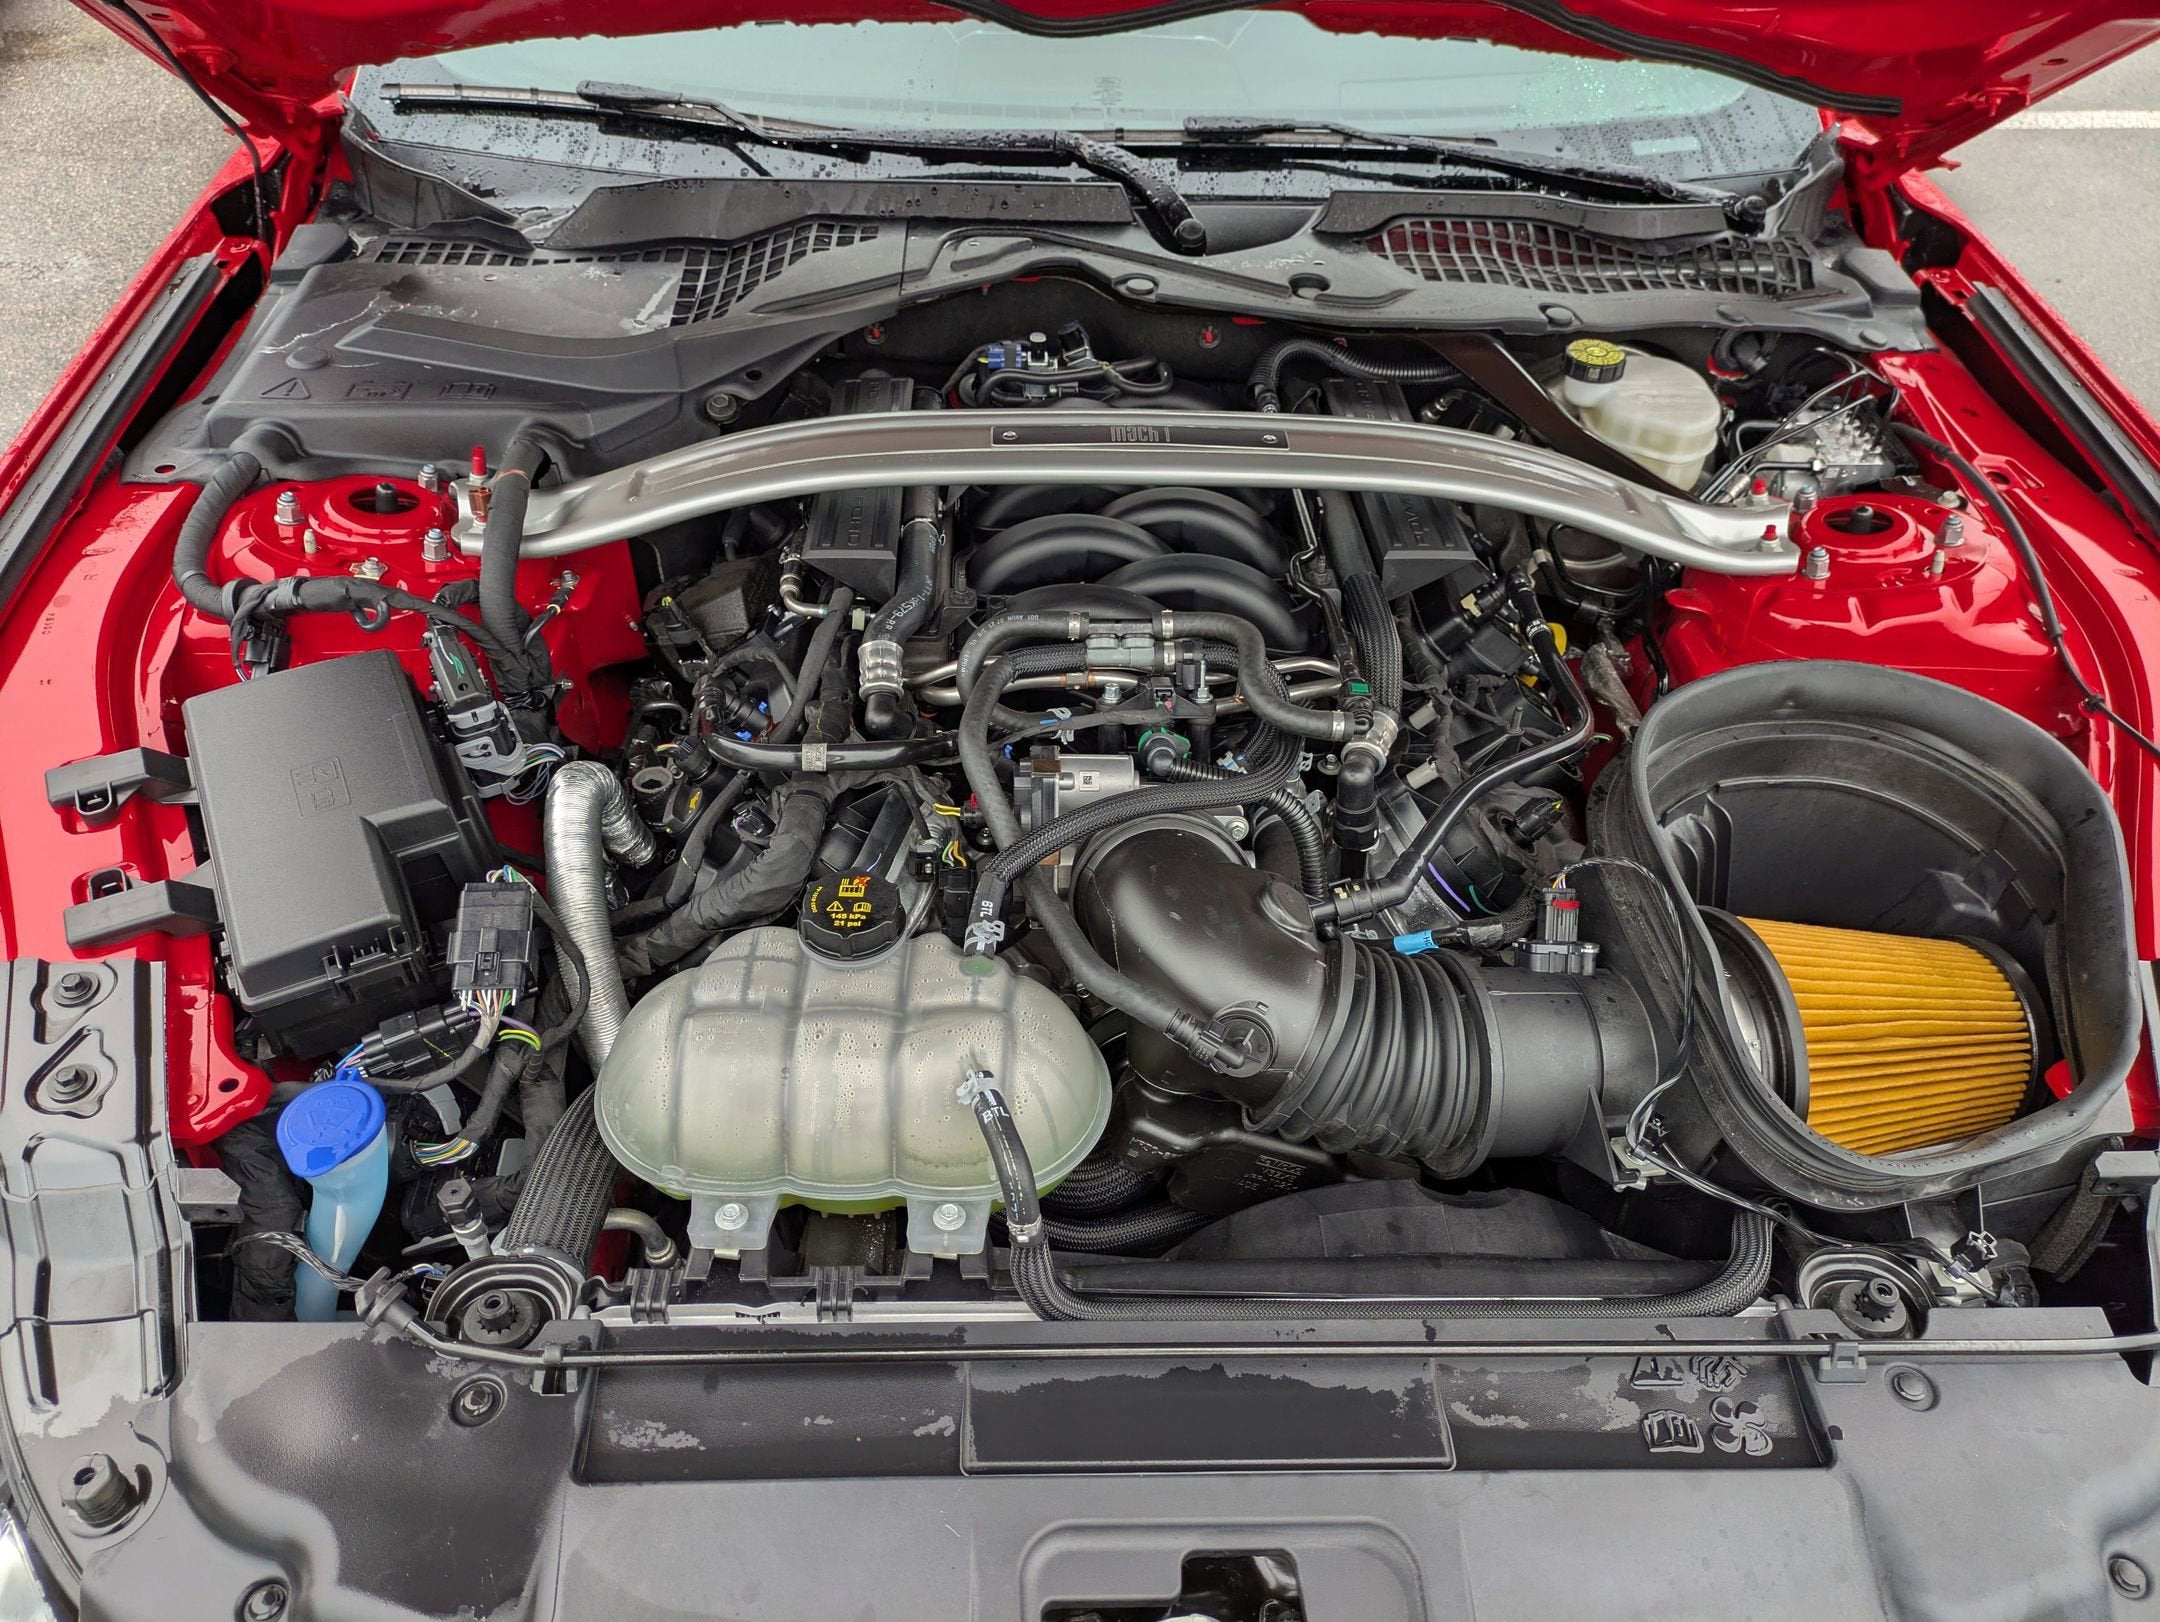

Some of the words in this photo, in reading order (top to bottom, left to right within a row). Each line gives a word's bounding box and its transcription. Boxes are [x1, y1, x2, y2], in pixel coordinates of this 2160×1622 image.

[1163, 425, 1171, 442] 1
[980, 900, 994, 918] BTL
[982, 1106, 1010, 1124] BTL
